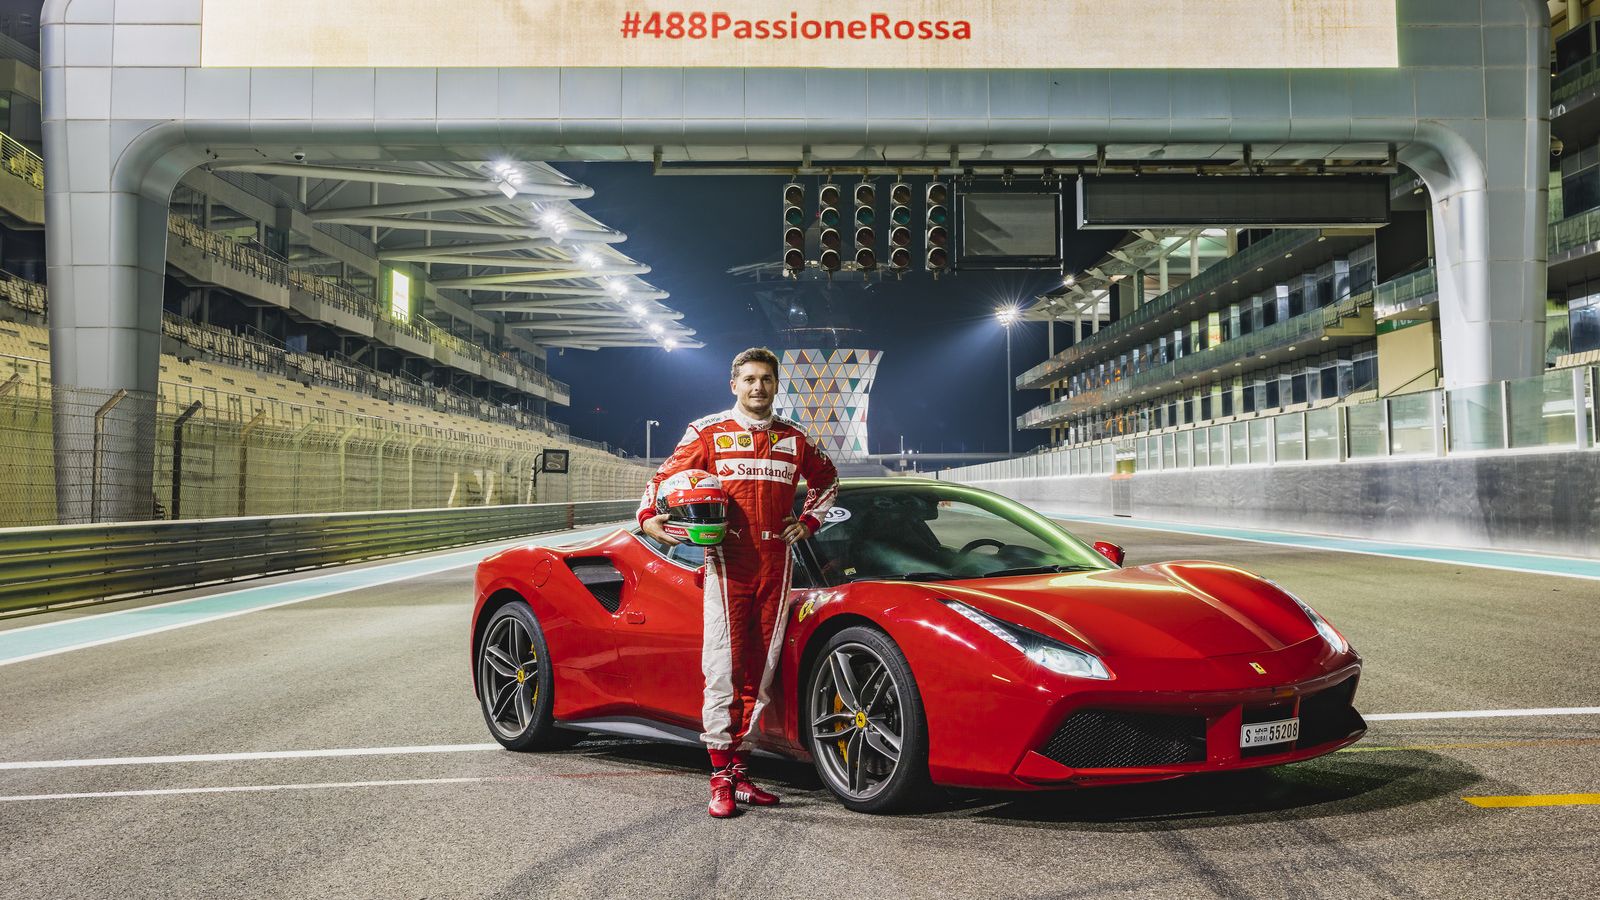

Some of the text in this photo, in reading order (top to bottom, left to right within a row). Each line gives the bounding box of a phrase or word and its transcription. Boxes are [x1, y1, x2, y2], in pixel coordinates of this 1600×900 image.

[620, 11, 972, 40] #488PassioneRossa
[1245, 722, 1297, 743] S 55208
